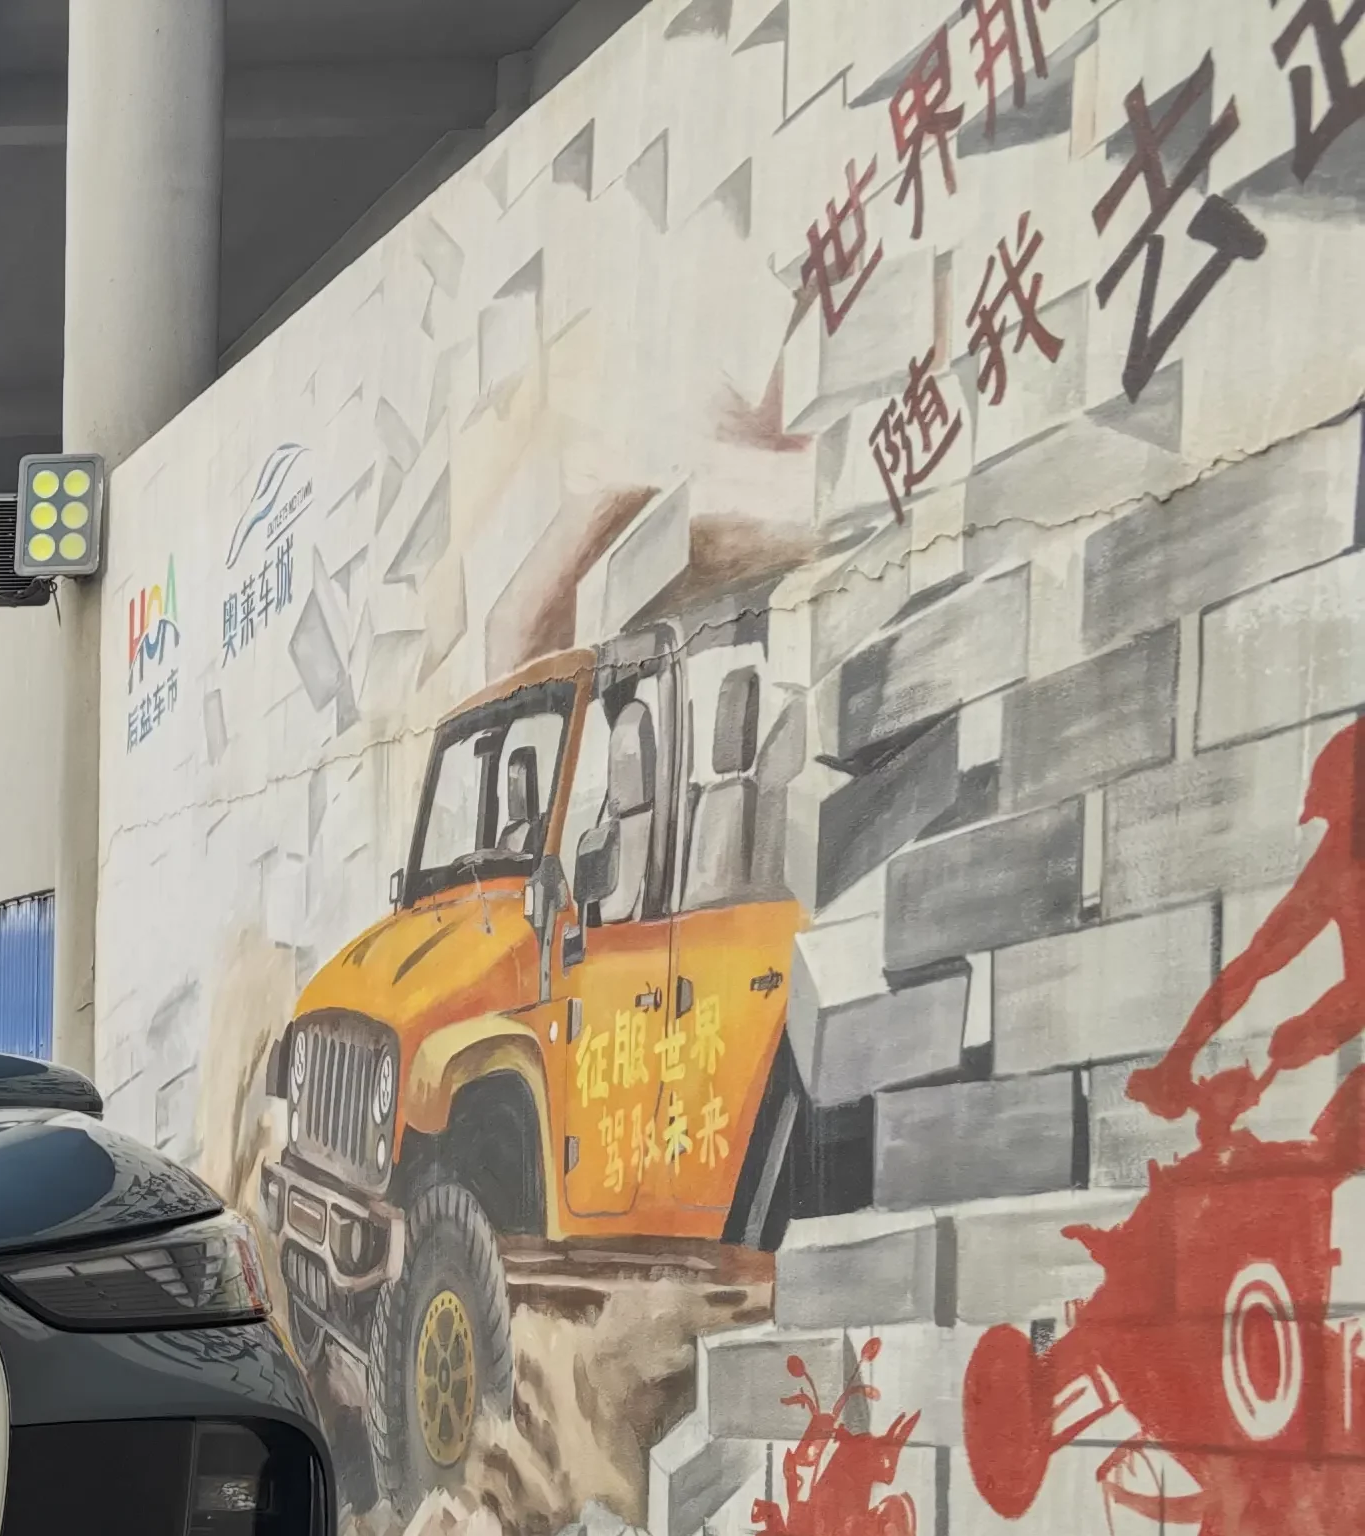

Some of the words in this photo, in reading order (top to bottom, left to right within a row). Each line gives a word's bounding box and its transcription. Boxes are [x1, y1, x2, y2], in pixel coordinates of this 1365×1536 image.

[222, 533, 294, 668] 奥莱车城
[575, 994, 726, 1108] 征服世界
[598, 1082, 730, 1192] 驾驭未来
